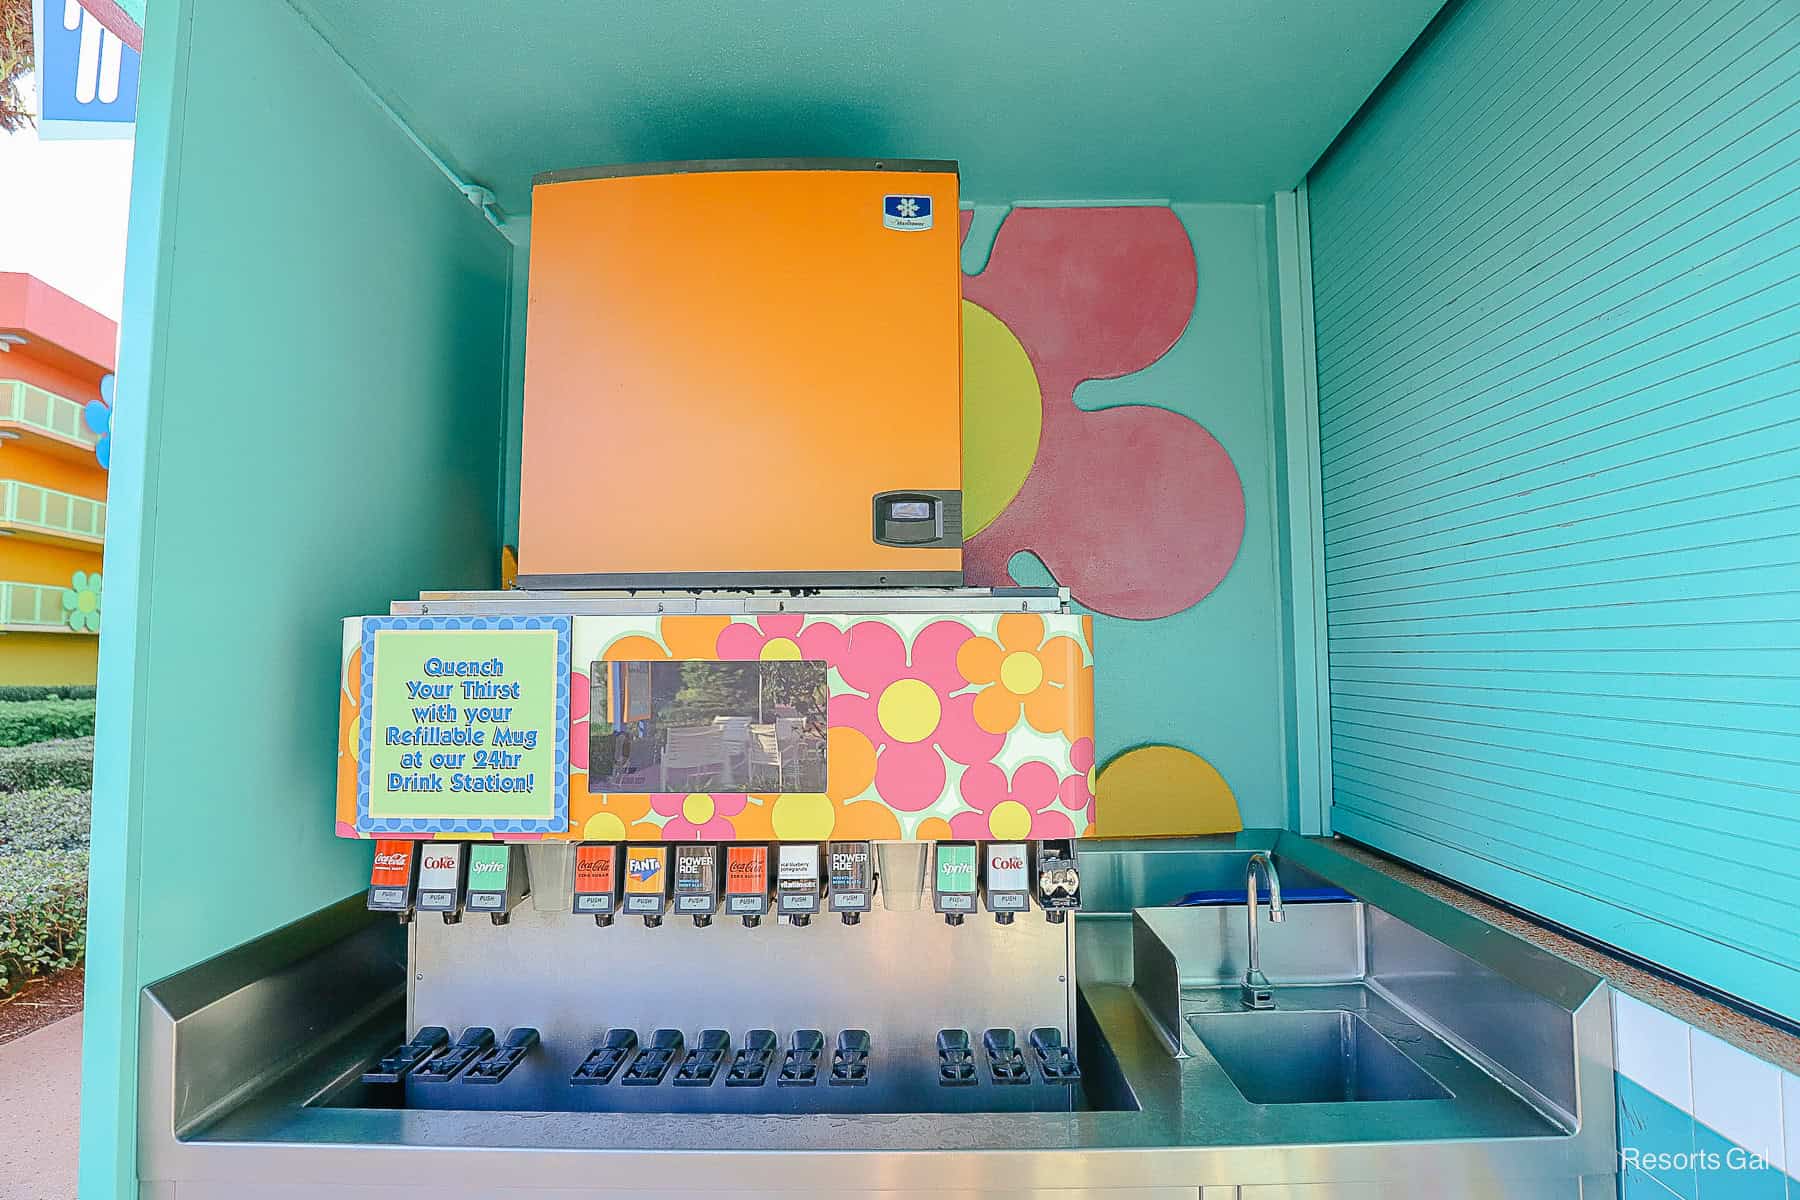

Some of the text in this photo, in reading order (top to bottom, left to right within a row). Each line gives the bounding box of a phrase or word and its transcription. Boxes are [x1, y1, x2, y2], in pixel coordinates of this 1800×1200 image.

[424, 657, 504, 677] Quench
[406, 681, 520, 700] Your Thirst
[412, 704, 512, 726] with your
[386, 726, 538, 749] Refillable Mug
[400, 750, 522, 769] at our 24hr
[388, 773, 535, 793] Drink Station!
[425, 856, 456, 869] Coke
[679, 857, 713, 866] POWER
[832, 853, 868, 862] POWER
[992, 857, 1023, 869] Coke
[472, 860, 504, 874] Sprite
[629, 858, 661, 872] FANTA
[679, 866, 699, 874] ADE
[832, 862, 853, 871] ADE
[942, 862, 973, 875] Sprite
